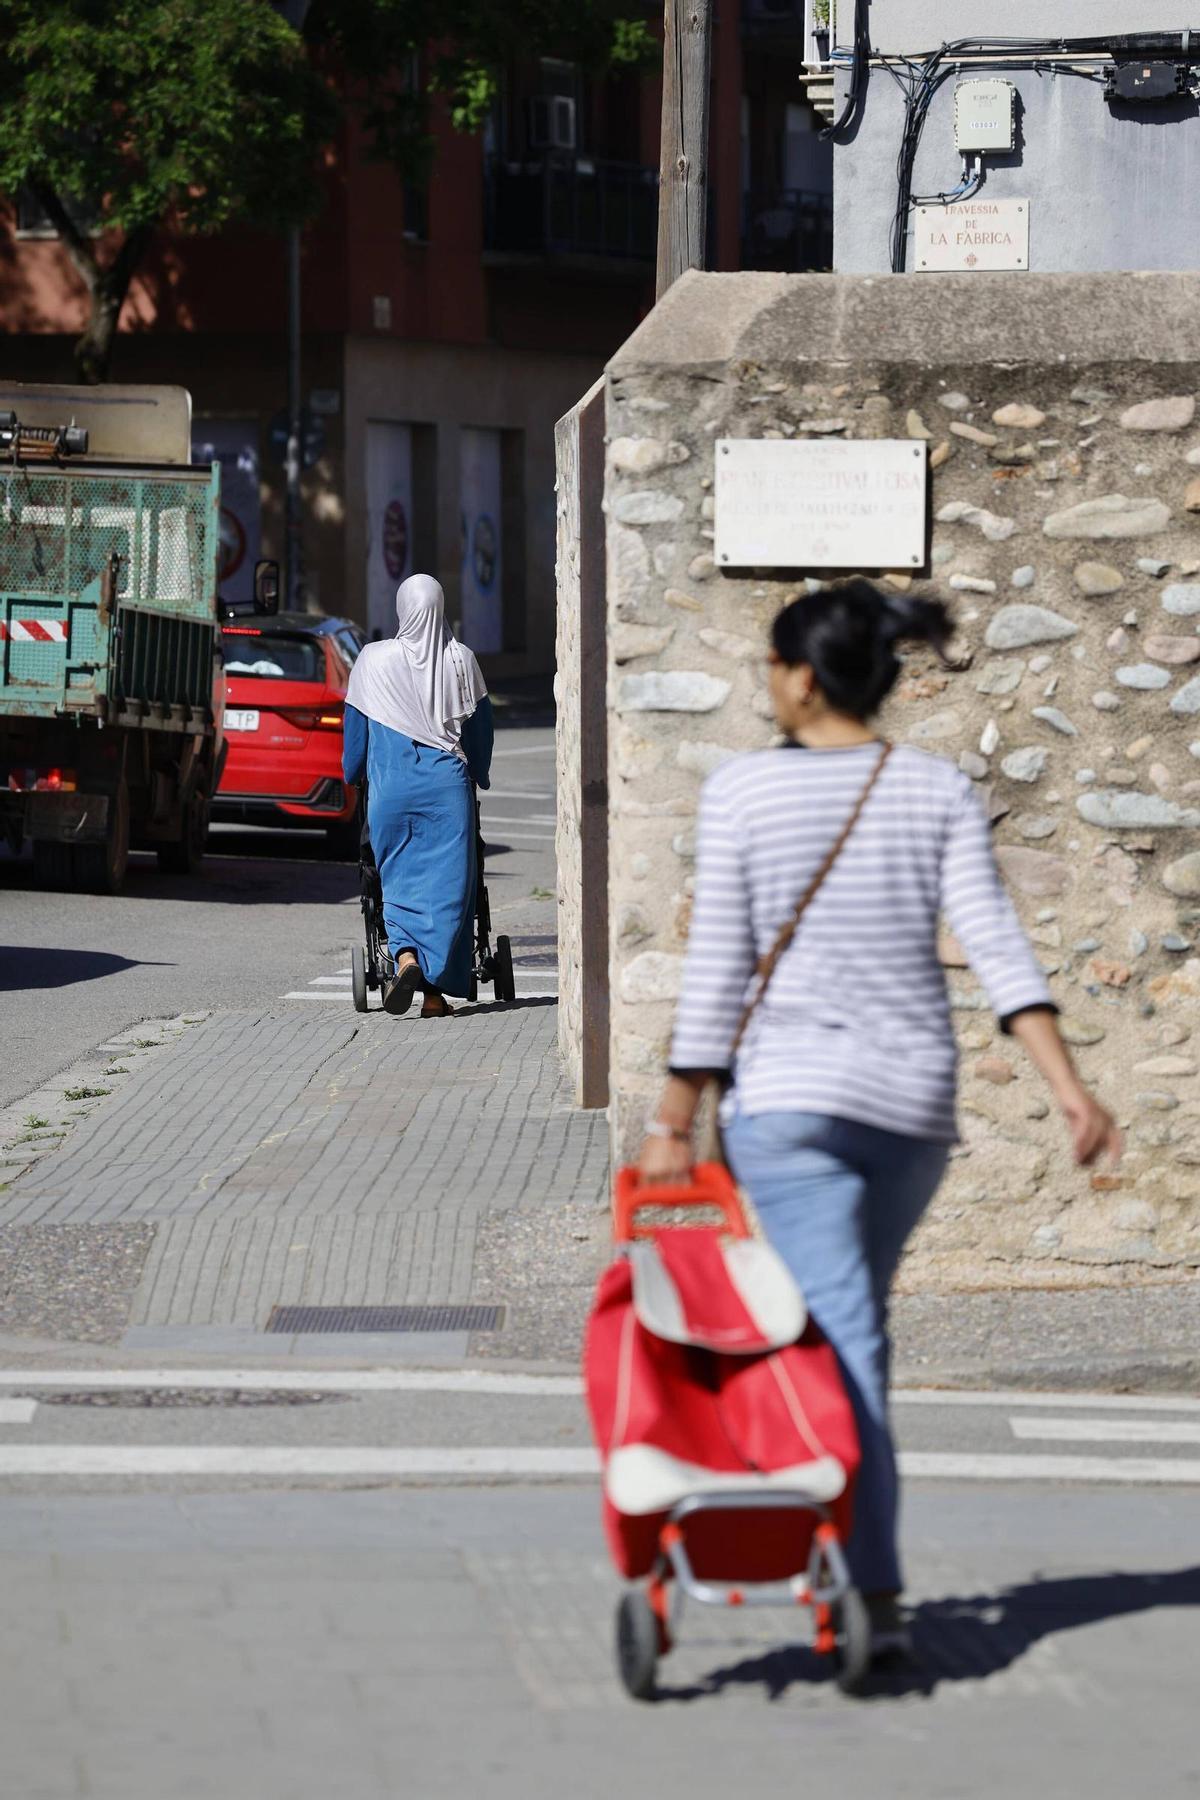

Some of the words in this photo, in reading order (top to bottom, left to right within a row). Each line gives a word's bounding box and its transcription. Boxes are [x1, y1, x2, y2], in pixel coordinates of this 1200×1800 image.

[944, 205, 999, 215] TRAVESSIA
[965, 219, 978, 229] DE
[930, 233, 948, 245] LA
[225, 713, 255, 727] LTP
